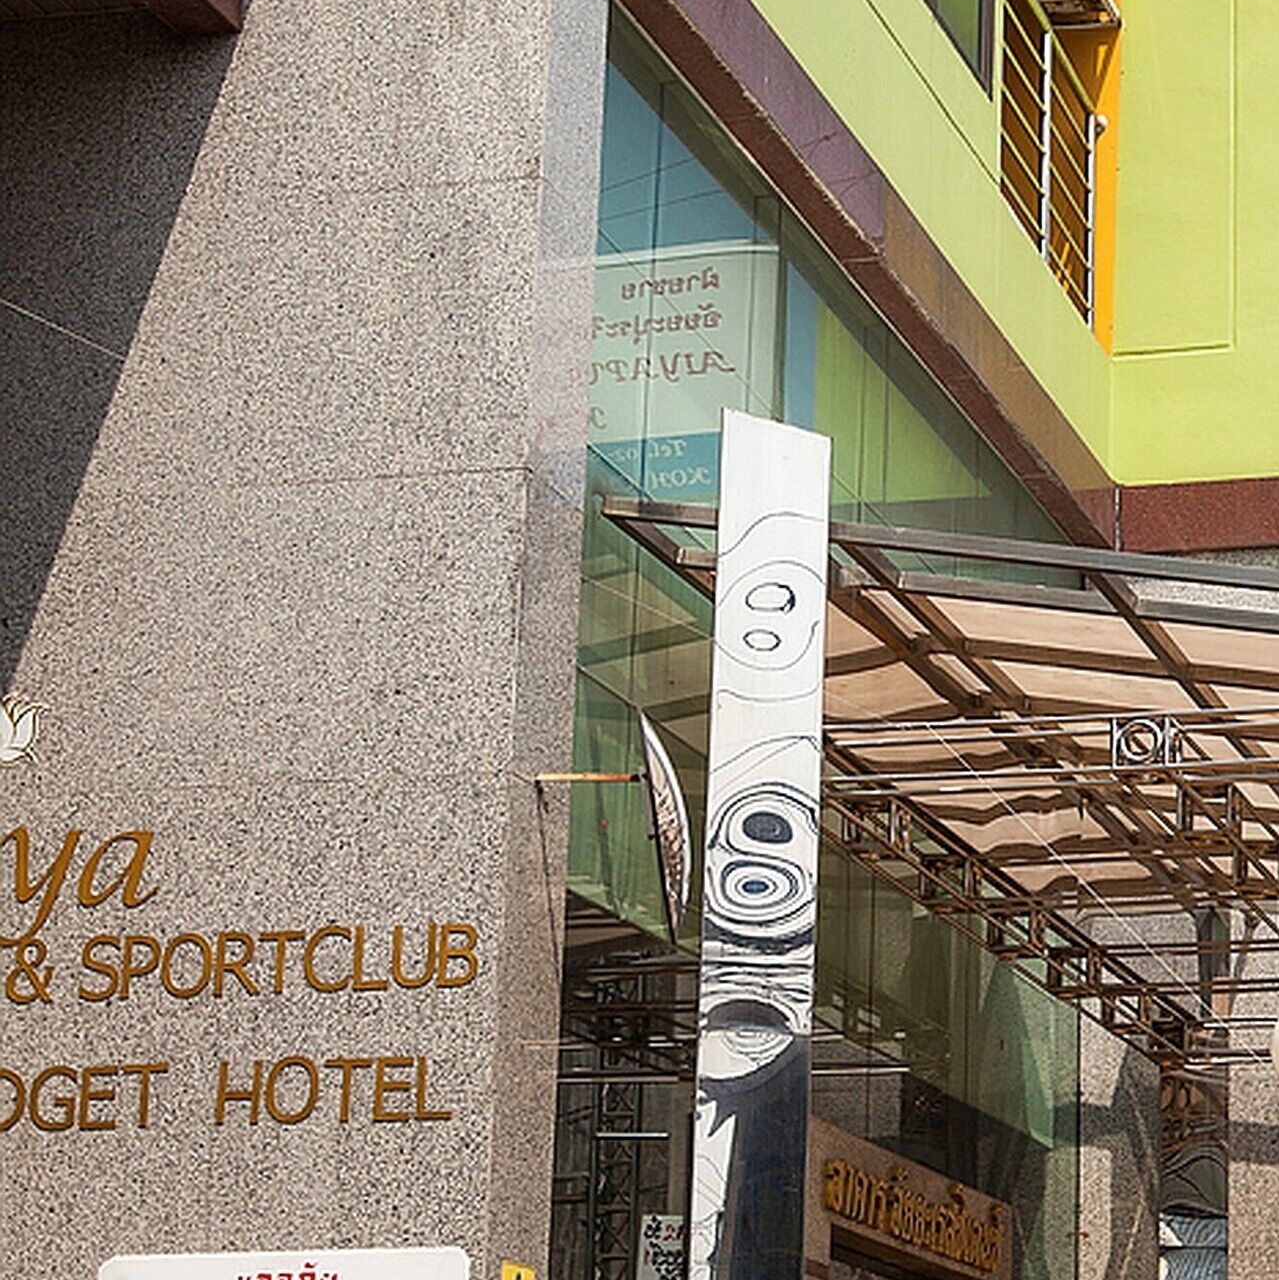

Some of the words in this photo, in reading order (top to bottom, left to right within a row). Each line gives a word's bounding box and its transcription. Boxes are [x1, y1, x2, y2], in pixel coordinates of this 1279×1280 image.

[6, 939, 55, 1005] &
[79, 923, 480, 1003] SPORTCLUB
[214, 1055, 452, 1127] HOTEL
